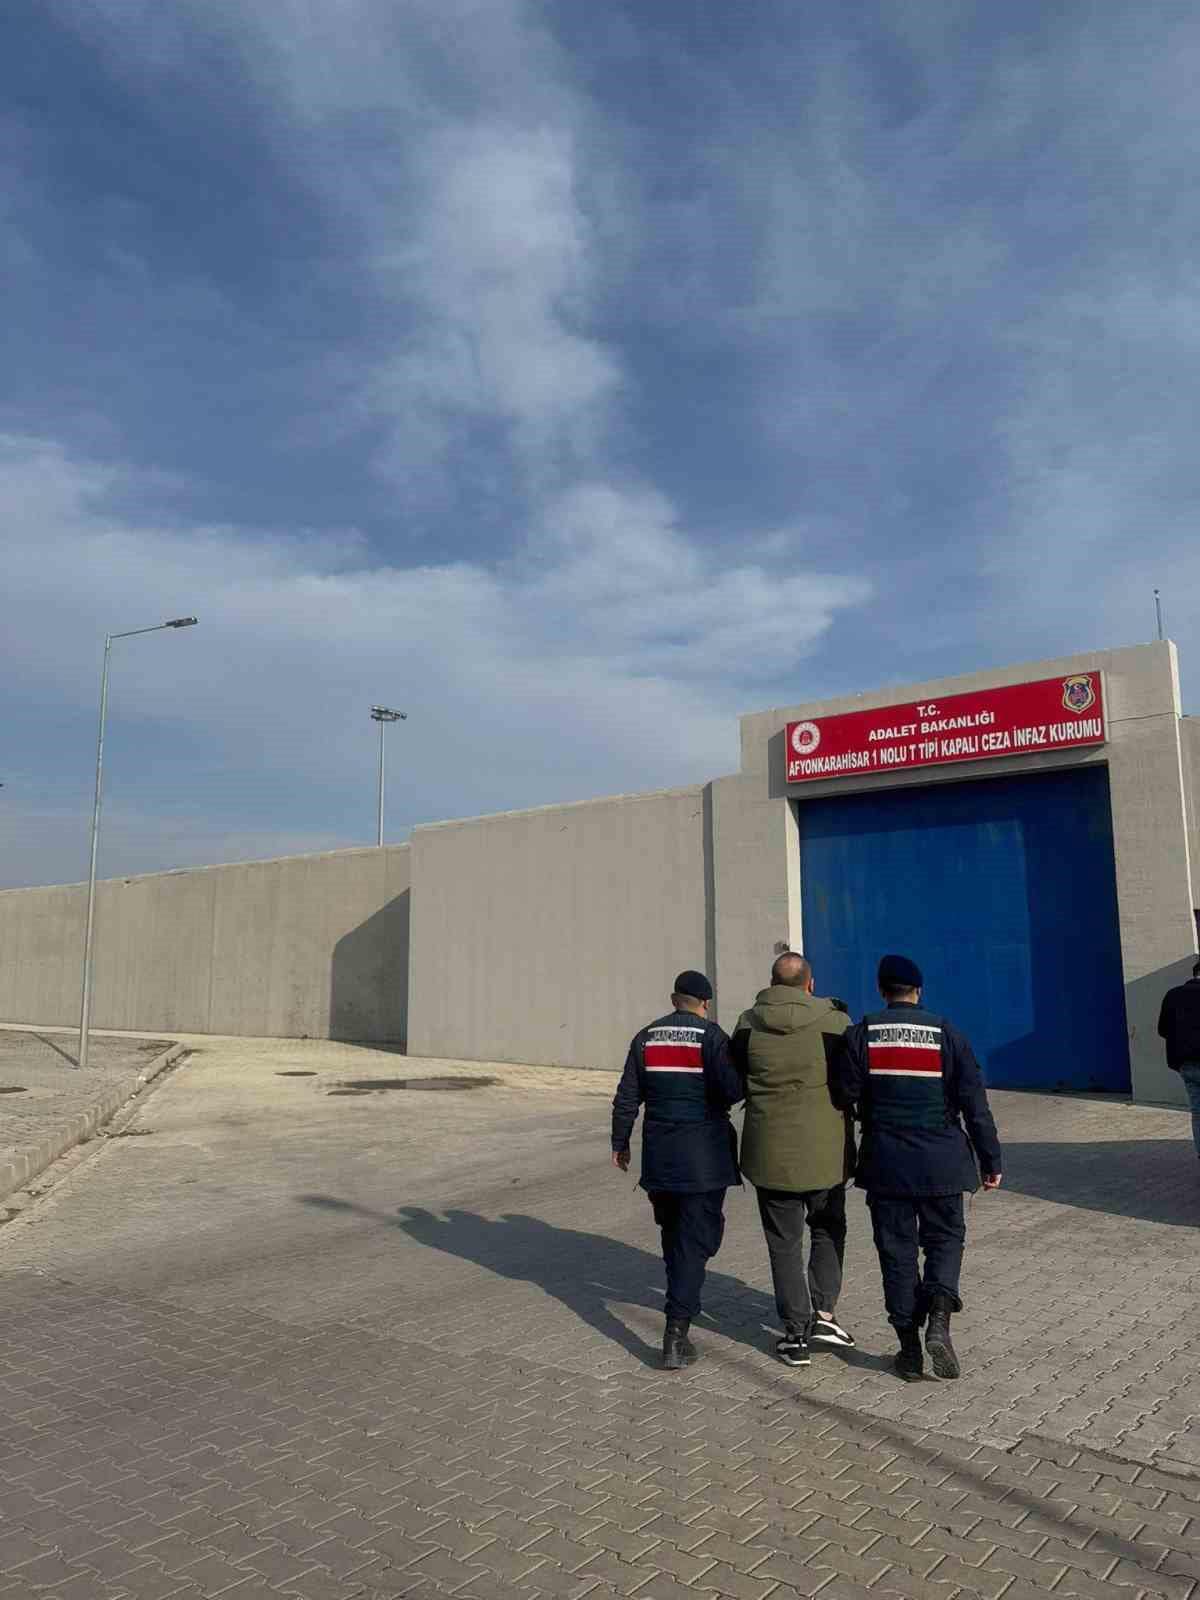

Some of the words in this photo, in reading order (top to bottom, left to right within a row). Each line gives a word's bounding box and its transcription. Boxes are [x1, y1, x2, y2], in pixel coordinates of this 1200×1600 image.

[916, 704, 941, 718] T.C.
[868, 723, 917, 742] ADALET
[920, 710, 995, 734] BAKANLIĞI
[789, 749, 870, 777] AFYONKARAHİSAR
[872, 752, 877, 766] 1
[880, 747, 907, 765] NOLU
[909, 744, 917, 761] T
[918, 737, 939, 760] TİPİ
[941, 735, 979, 757] KAPALI
[981, 731, 1011, 752] CEZA
[1013, 725, 1047, 747] İNFAZ
[1050, 717, 1101, 742] KURUMU
[876, 1028, 936, 1044] JANDARMA
